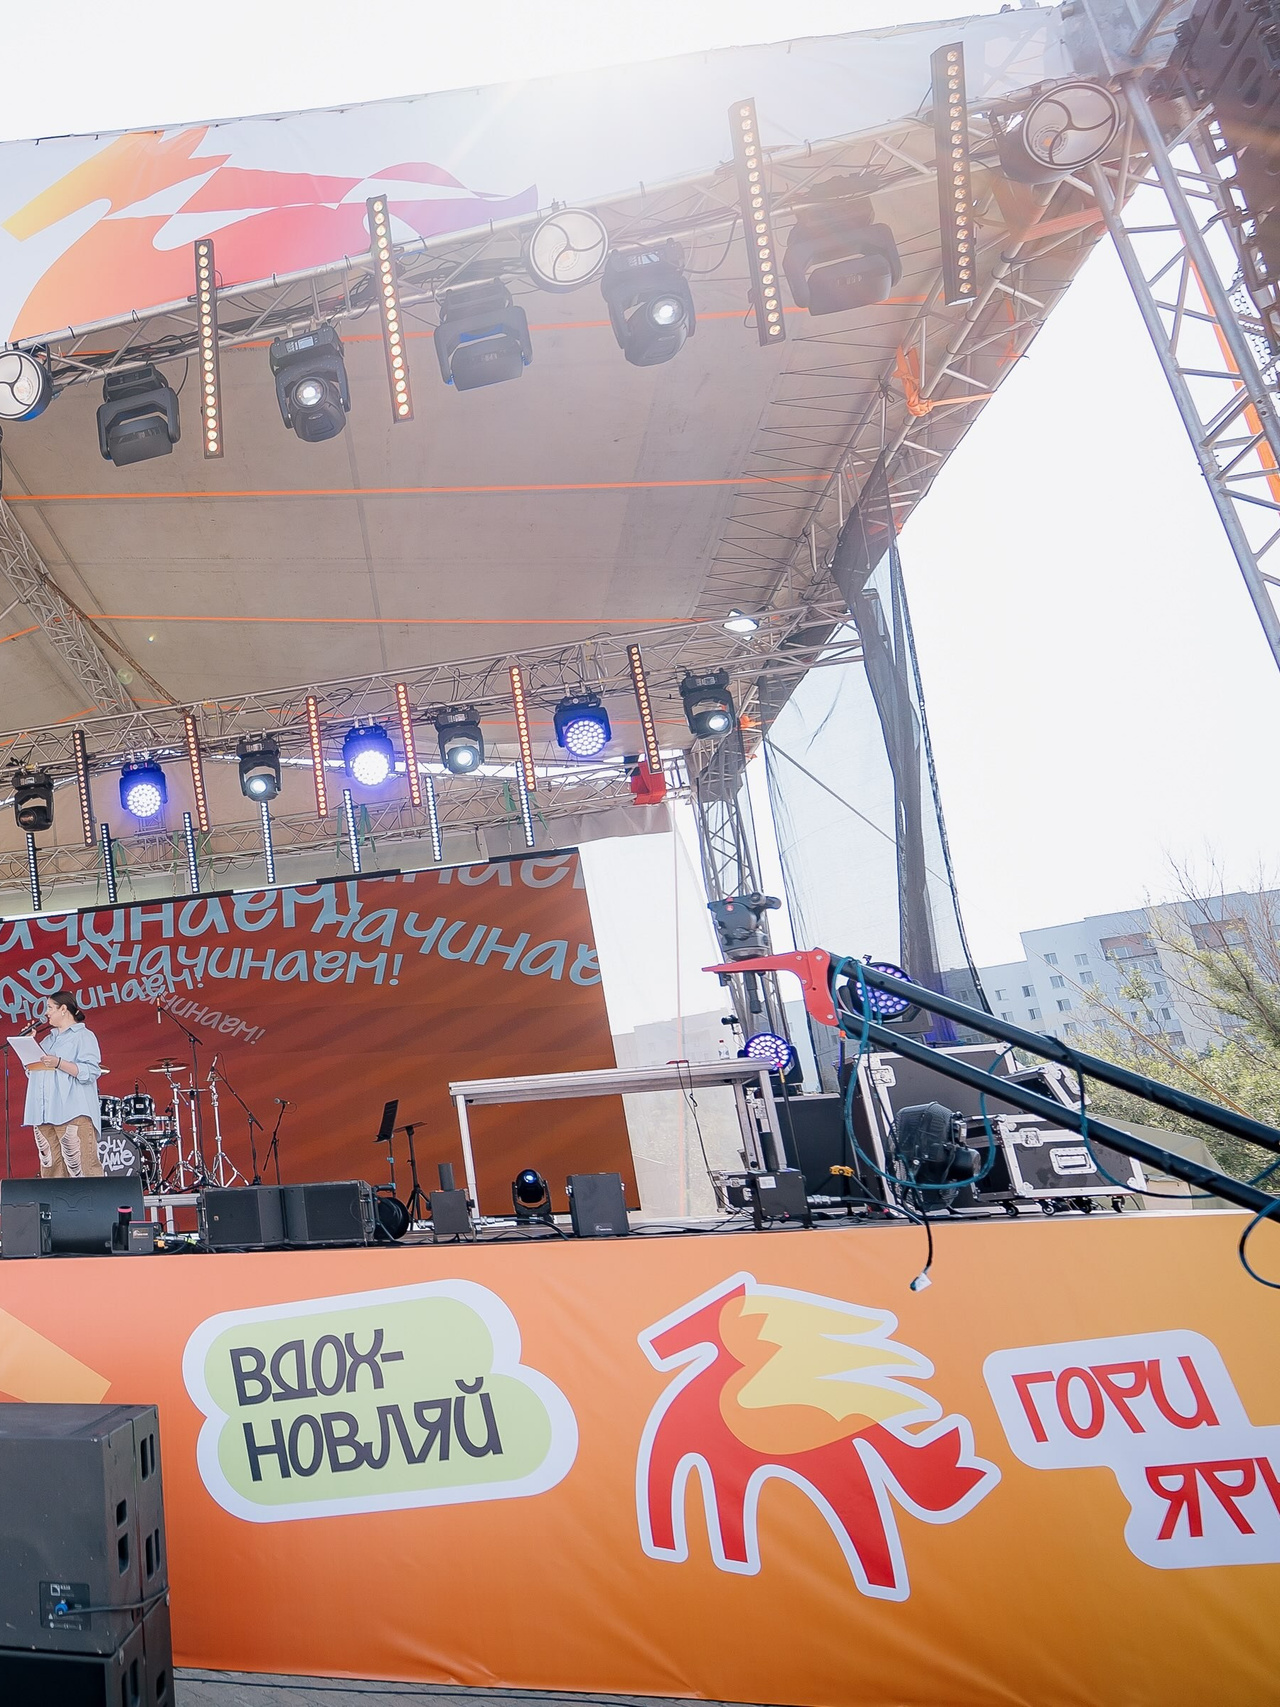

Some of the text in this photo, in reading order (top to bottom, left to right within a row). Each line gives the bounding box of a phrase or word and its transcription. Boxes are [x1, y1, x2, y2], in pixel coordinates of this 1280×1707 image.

[107, 943, 404, 986] начинаем!
[229, 1328, 405, 1406] ВДОХ-
[1011, 1355, 1221, 1443] ГОРИ
[242, 1376, 504, 1482] НОВЛЯЙ
